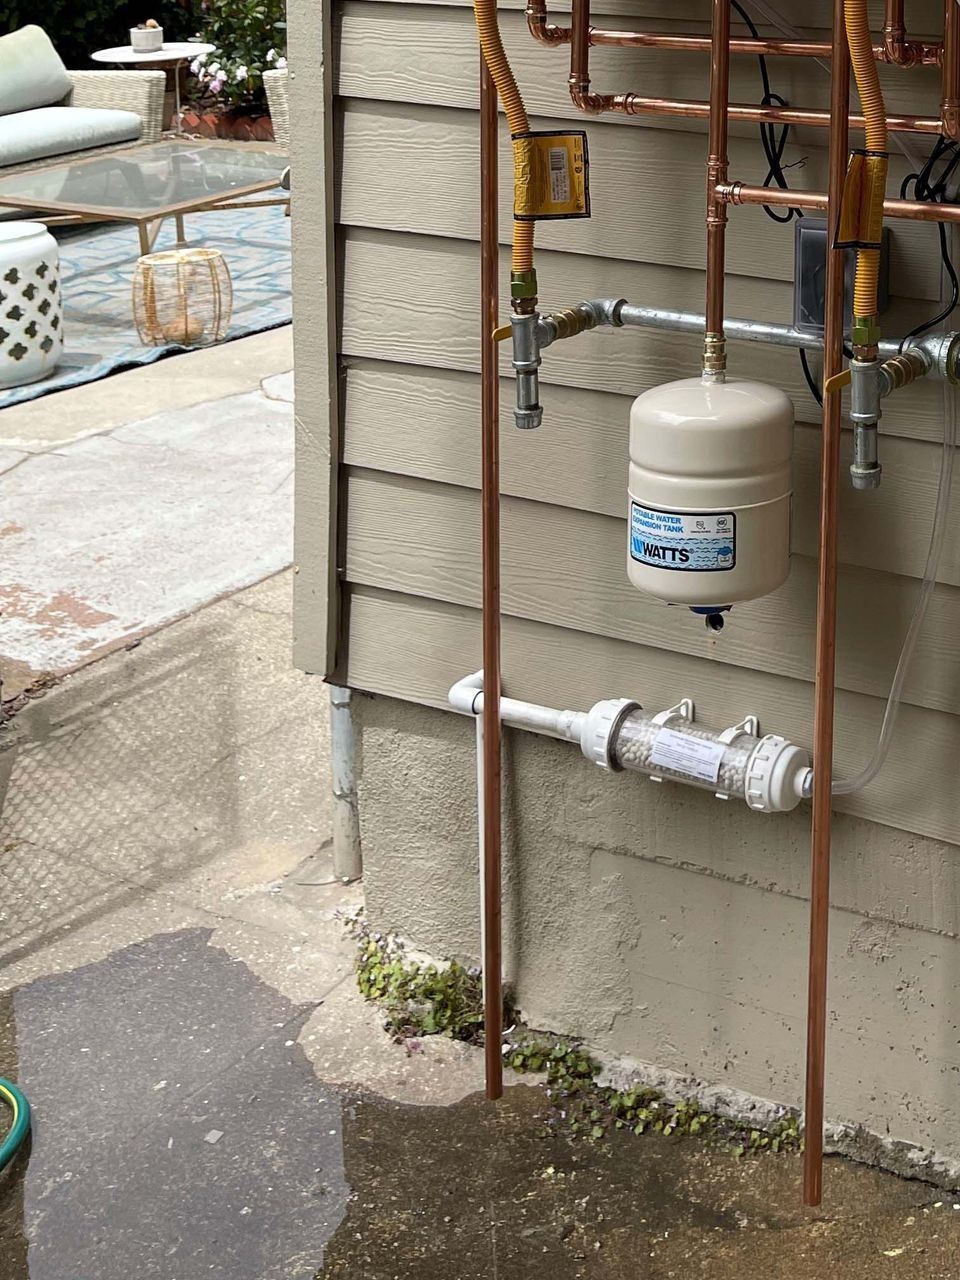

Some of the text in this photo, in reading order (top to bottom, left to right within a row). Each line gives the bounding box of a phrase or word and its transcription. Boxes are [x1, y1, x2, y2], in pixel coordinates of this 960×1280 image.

[655, 515, 682, 525] WATER
[662, 524, 684, 533] TANK
[643, 541, 690, 563] WATTS
